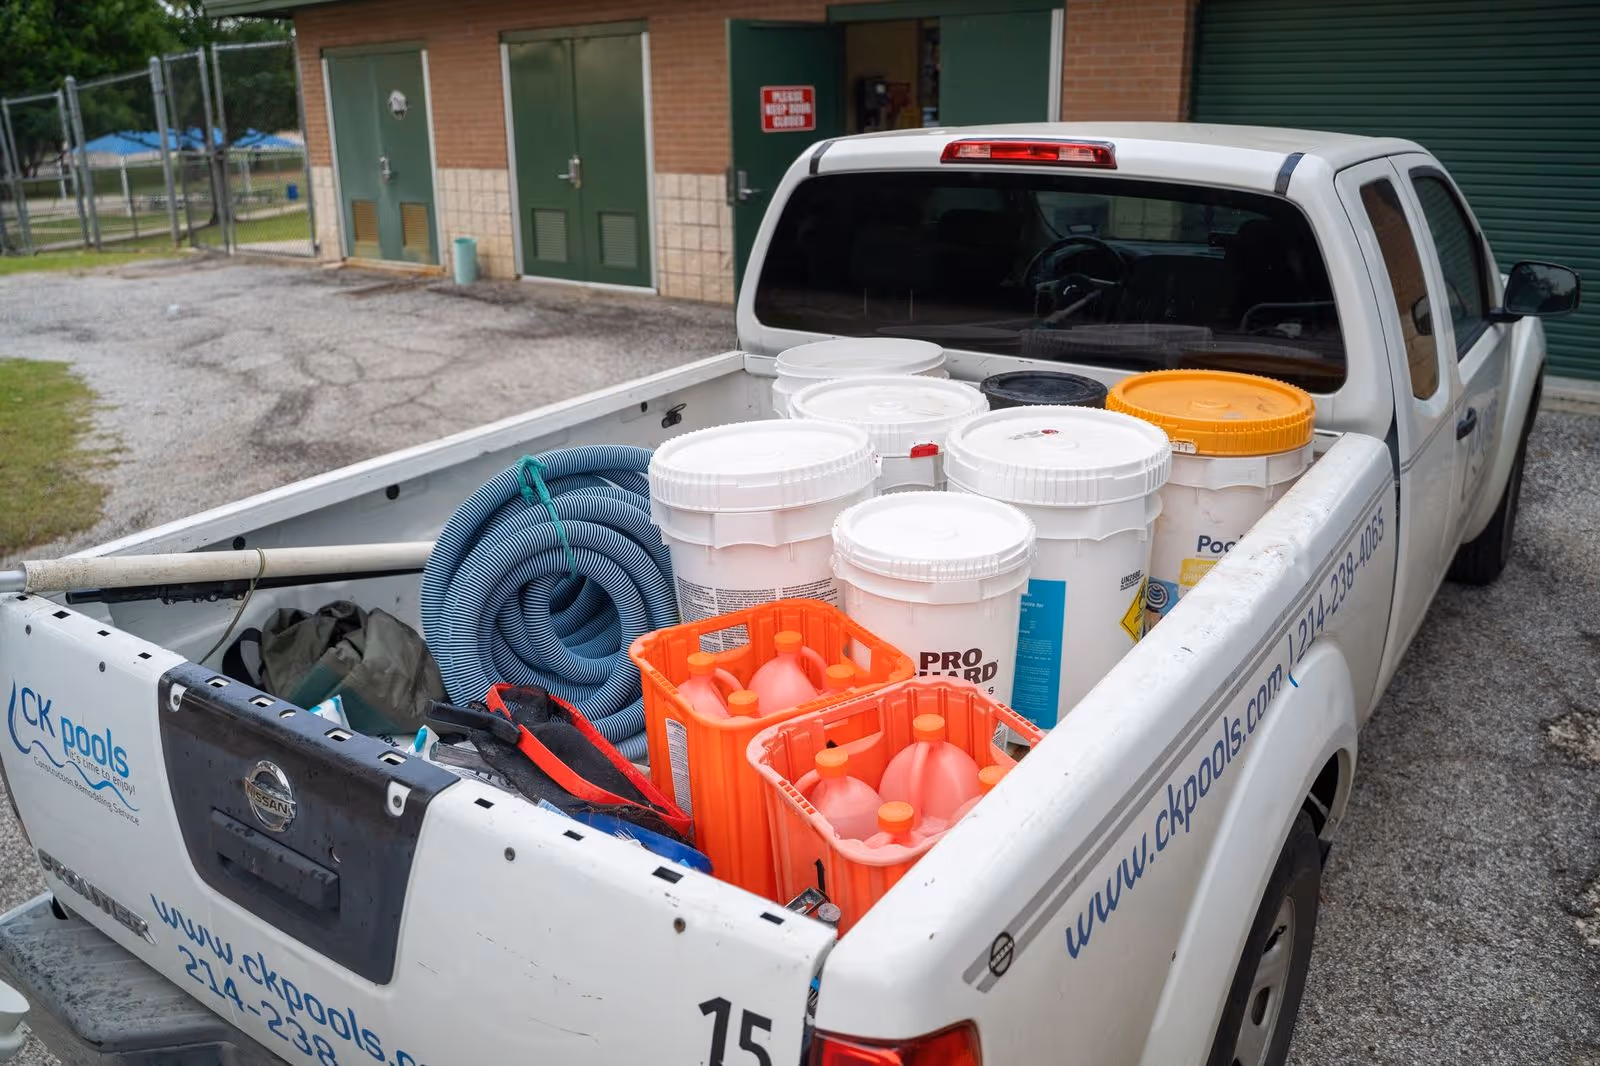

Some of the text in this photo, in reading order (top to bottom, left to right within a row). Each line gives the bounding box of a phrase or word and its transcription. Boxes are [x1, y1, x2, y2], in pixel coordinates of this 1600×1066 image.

[771, 91, 803, 102] PLEASE
[766, 103, 811, 115] KEEP DOOR
[773, 115, 805, 128] CLOSED
[1197, 535, 1243, 554] Poo
[920, 648, 983, 670] PRO
[21, 687, 130, 779] CK pools
[1065, 663, 1283, 959] www.ckpools.com
[1296, 506, 1384, 664] 214-238-4065
[82, 757, 100, 775] time
[101, 768, 111, 781] to
[245, 780, 289, 815] NISSAN
[150, 893, 426, 1066] www.ckpools.c
[698, 996, 773, 1066] 15
